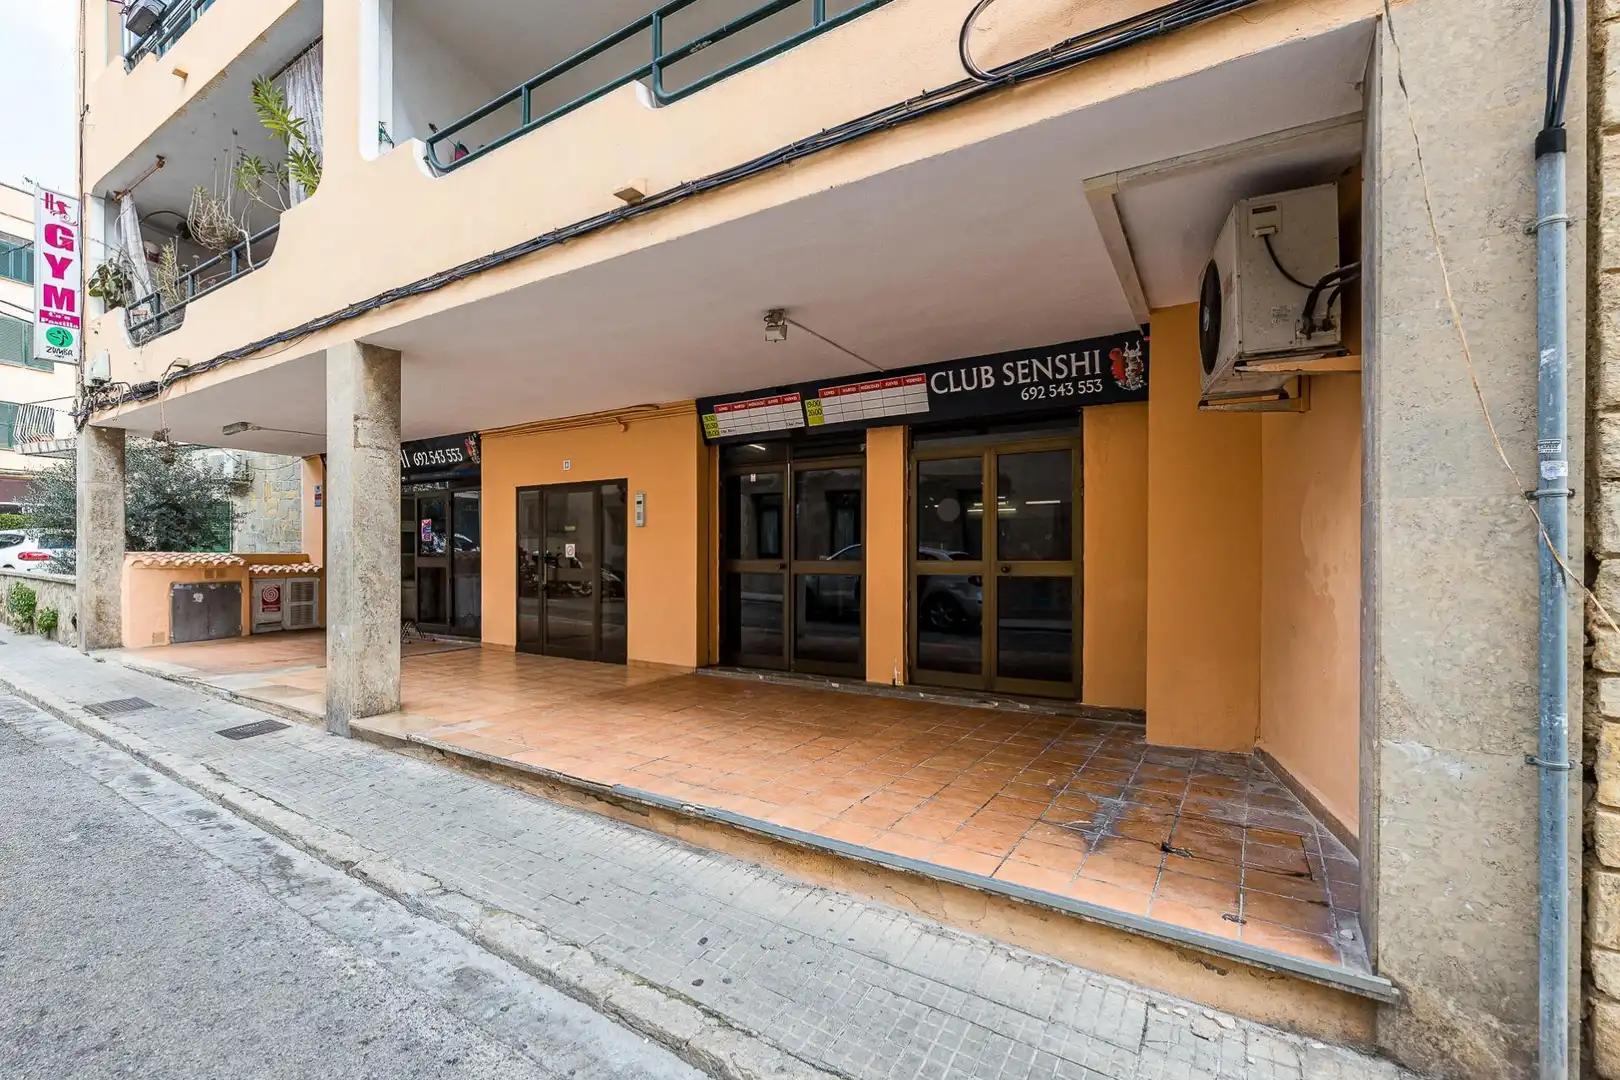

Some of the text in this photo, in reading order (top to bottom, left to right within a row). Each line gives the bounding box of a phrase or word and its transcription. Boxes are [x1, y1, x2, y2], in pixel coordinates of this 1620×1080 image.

[44, 223, 76, 312] GYM
[930, 350, 1102, 395] CLUB SENSHI
[1021, 378, 1103, 401] 692 543 553
[413, 452, 430, 466] 692
[428, 450, 445, 464] 543
[446, 448, 463, 462] 553
